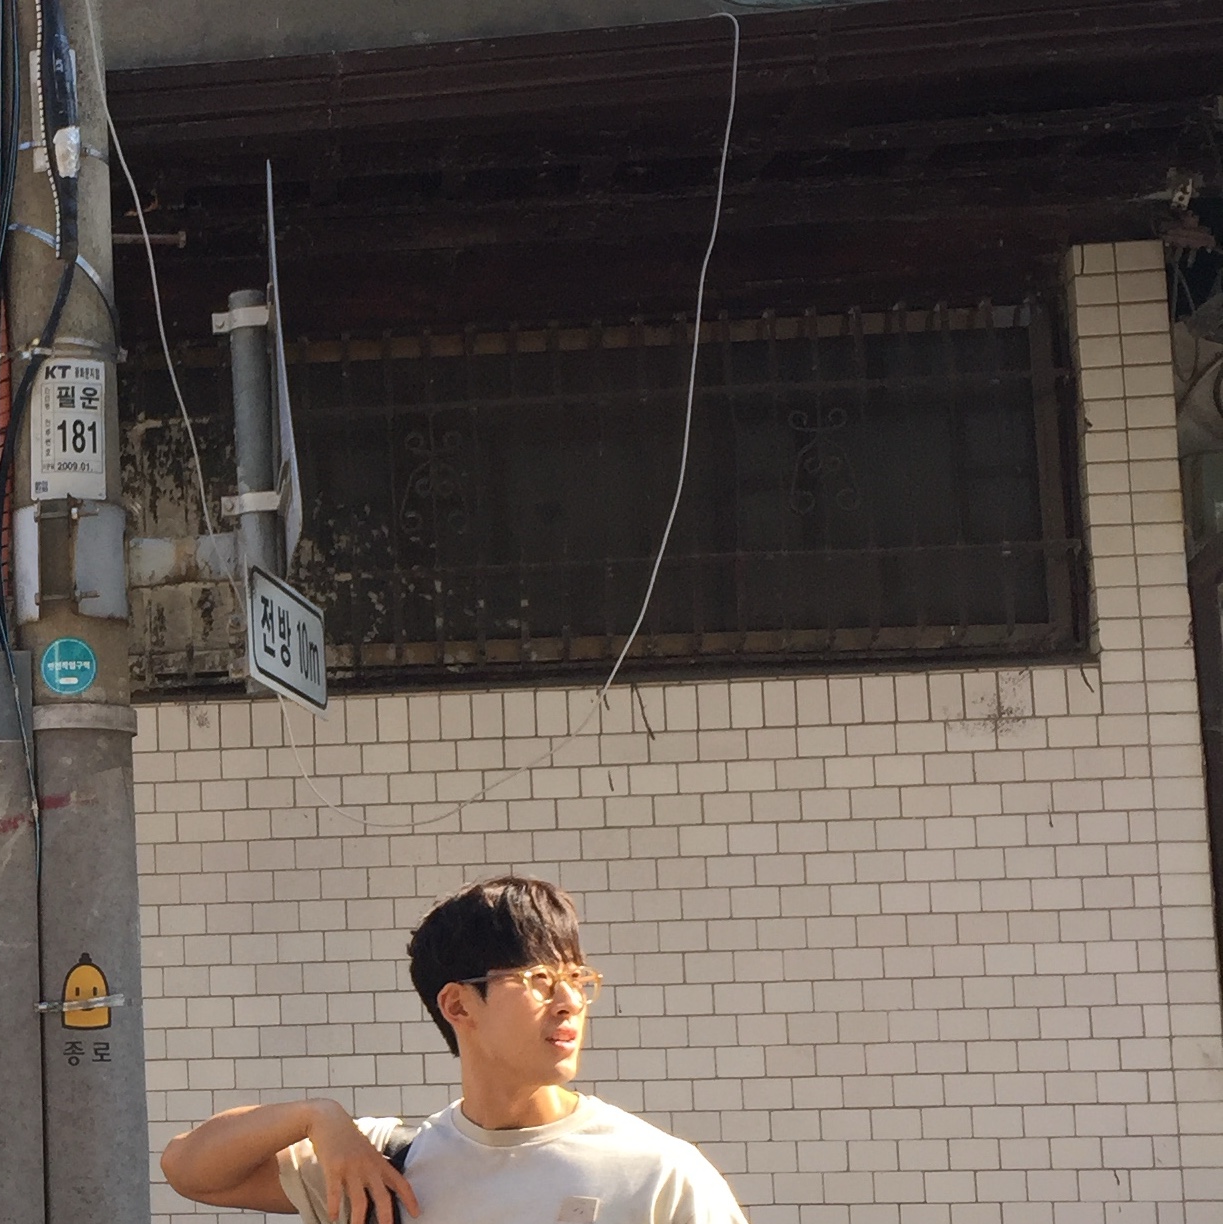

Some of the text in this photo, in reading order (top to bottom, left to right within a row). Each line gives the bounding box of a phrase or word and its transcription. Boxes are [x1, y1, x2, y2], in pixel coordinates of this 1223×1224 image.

[45, 365, 71, 380] KT
[57, 385, 99, 410] 필운
[57, 418, 97, 454] 181
[260, 595, 321, 686] 전방 10m
[63, 1041, 111, 1067] 종로
